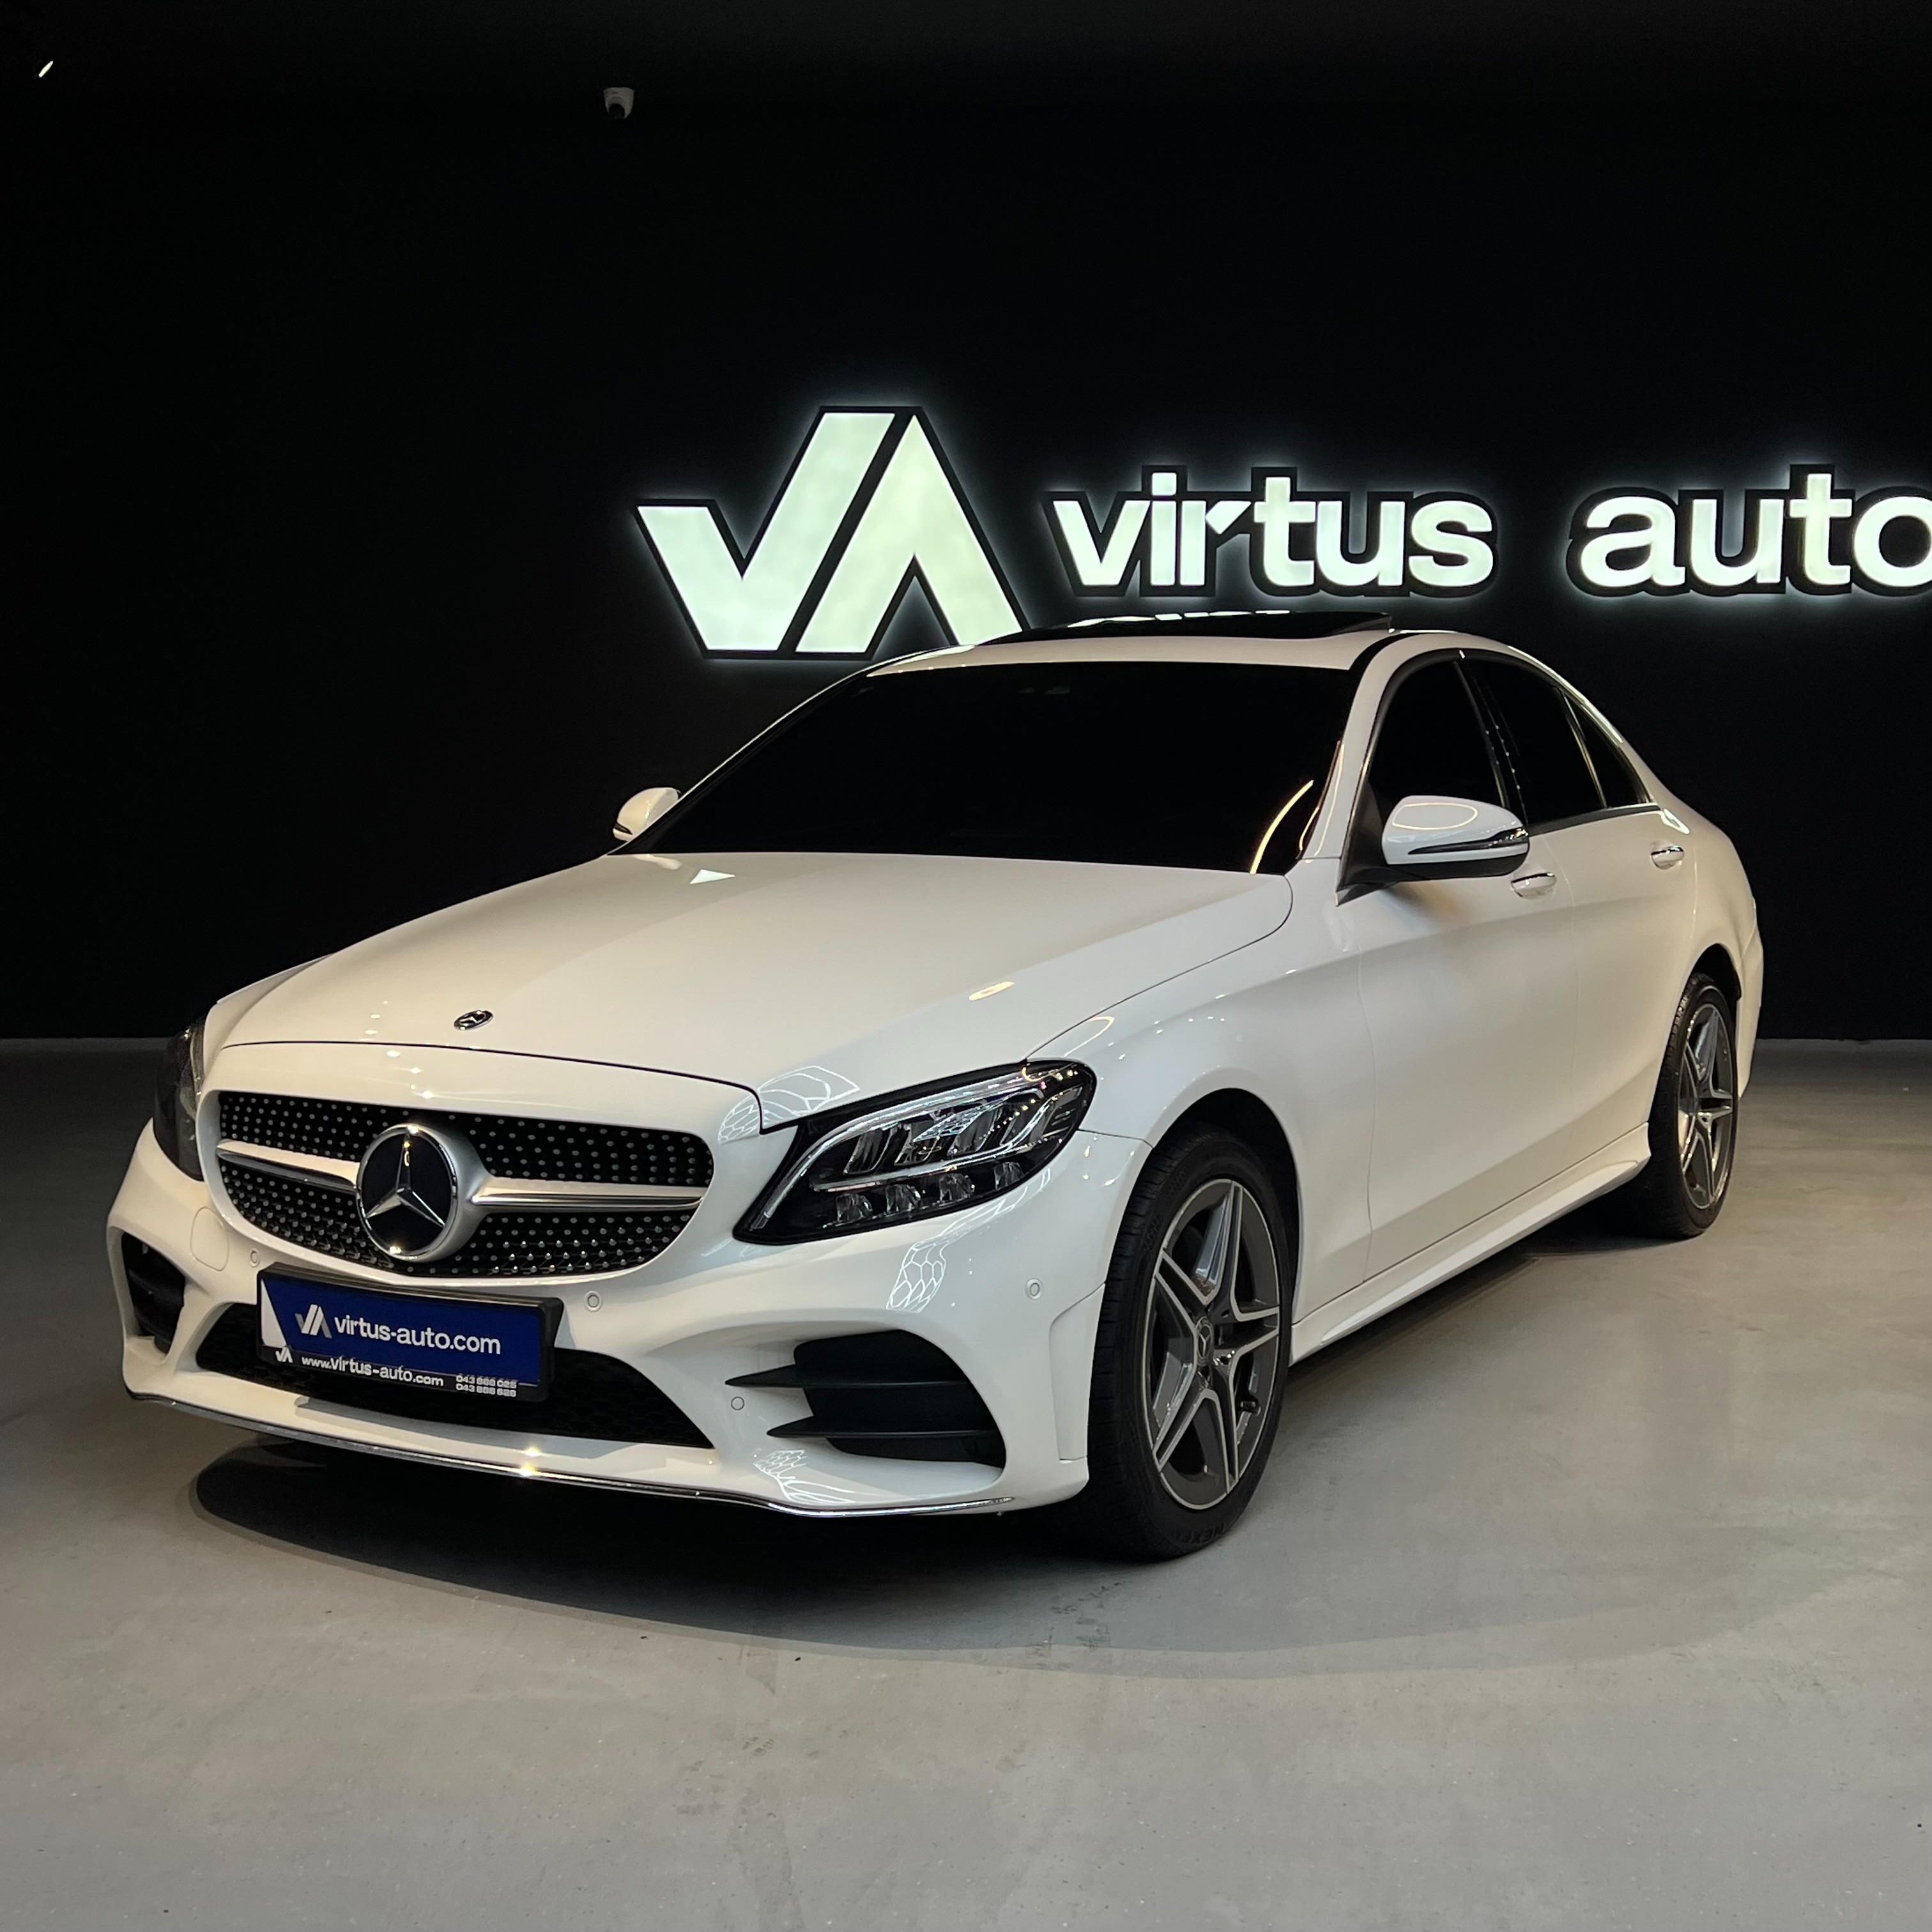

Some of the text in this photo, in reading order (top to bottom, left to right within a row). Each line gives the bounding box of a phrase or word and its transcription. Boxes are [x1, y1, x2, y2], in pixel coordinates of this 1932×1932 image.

[1051, 469, 1495, 588] virtus
[1579, 471, 1932, 588] auto
[334, 1314, 501, 1354] virtus-auto.com
[301, 1355, 445, 1387] www.virtus-auto.com
[456, 1375, 475, 1384] 043
